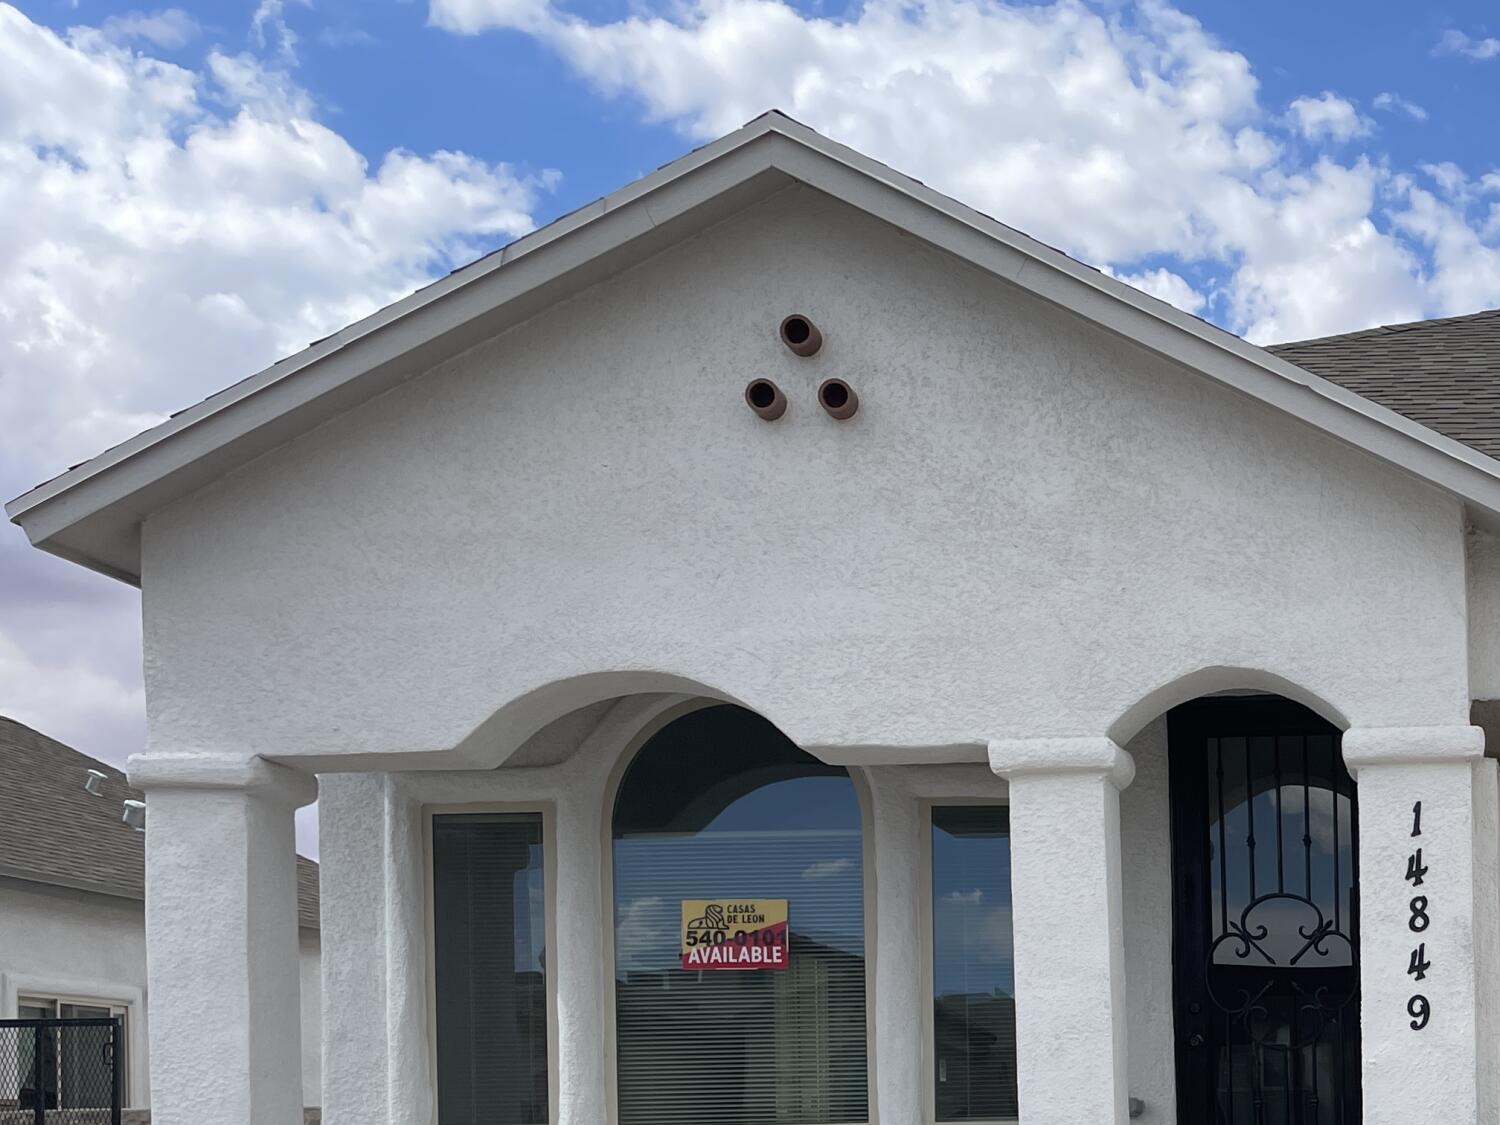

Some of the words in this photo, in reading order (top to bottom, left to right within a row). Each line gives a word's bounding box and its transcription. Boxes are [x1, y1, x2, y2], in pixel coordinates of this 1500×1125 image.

[727, 904, 756, 913] CASAS
[727, 914, 738, 923] DE
[742, 914, 765, 923] LEON
[1405, 801, 1431, 1031] 14849
[688, 946, 783, 963] AVAILABLE
